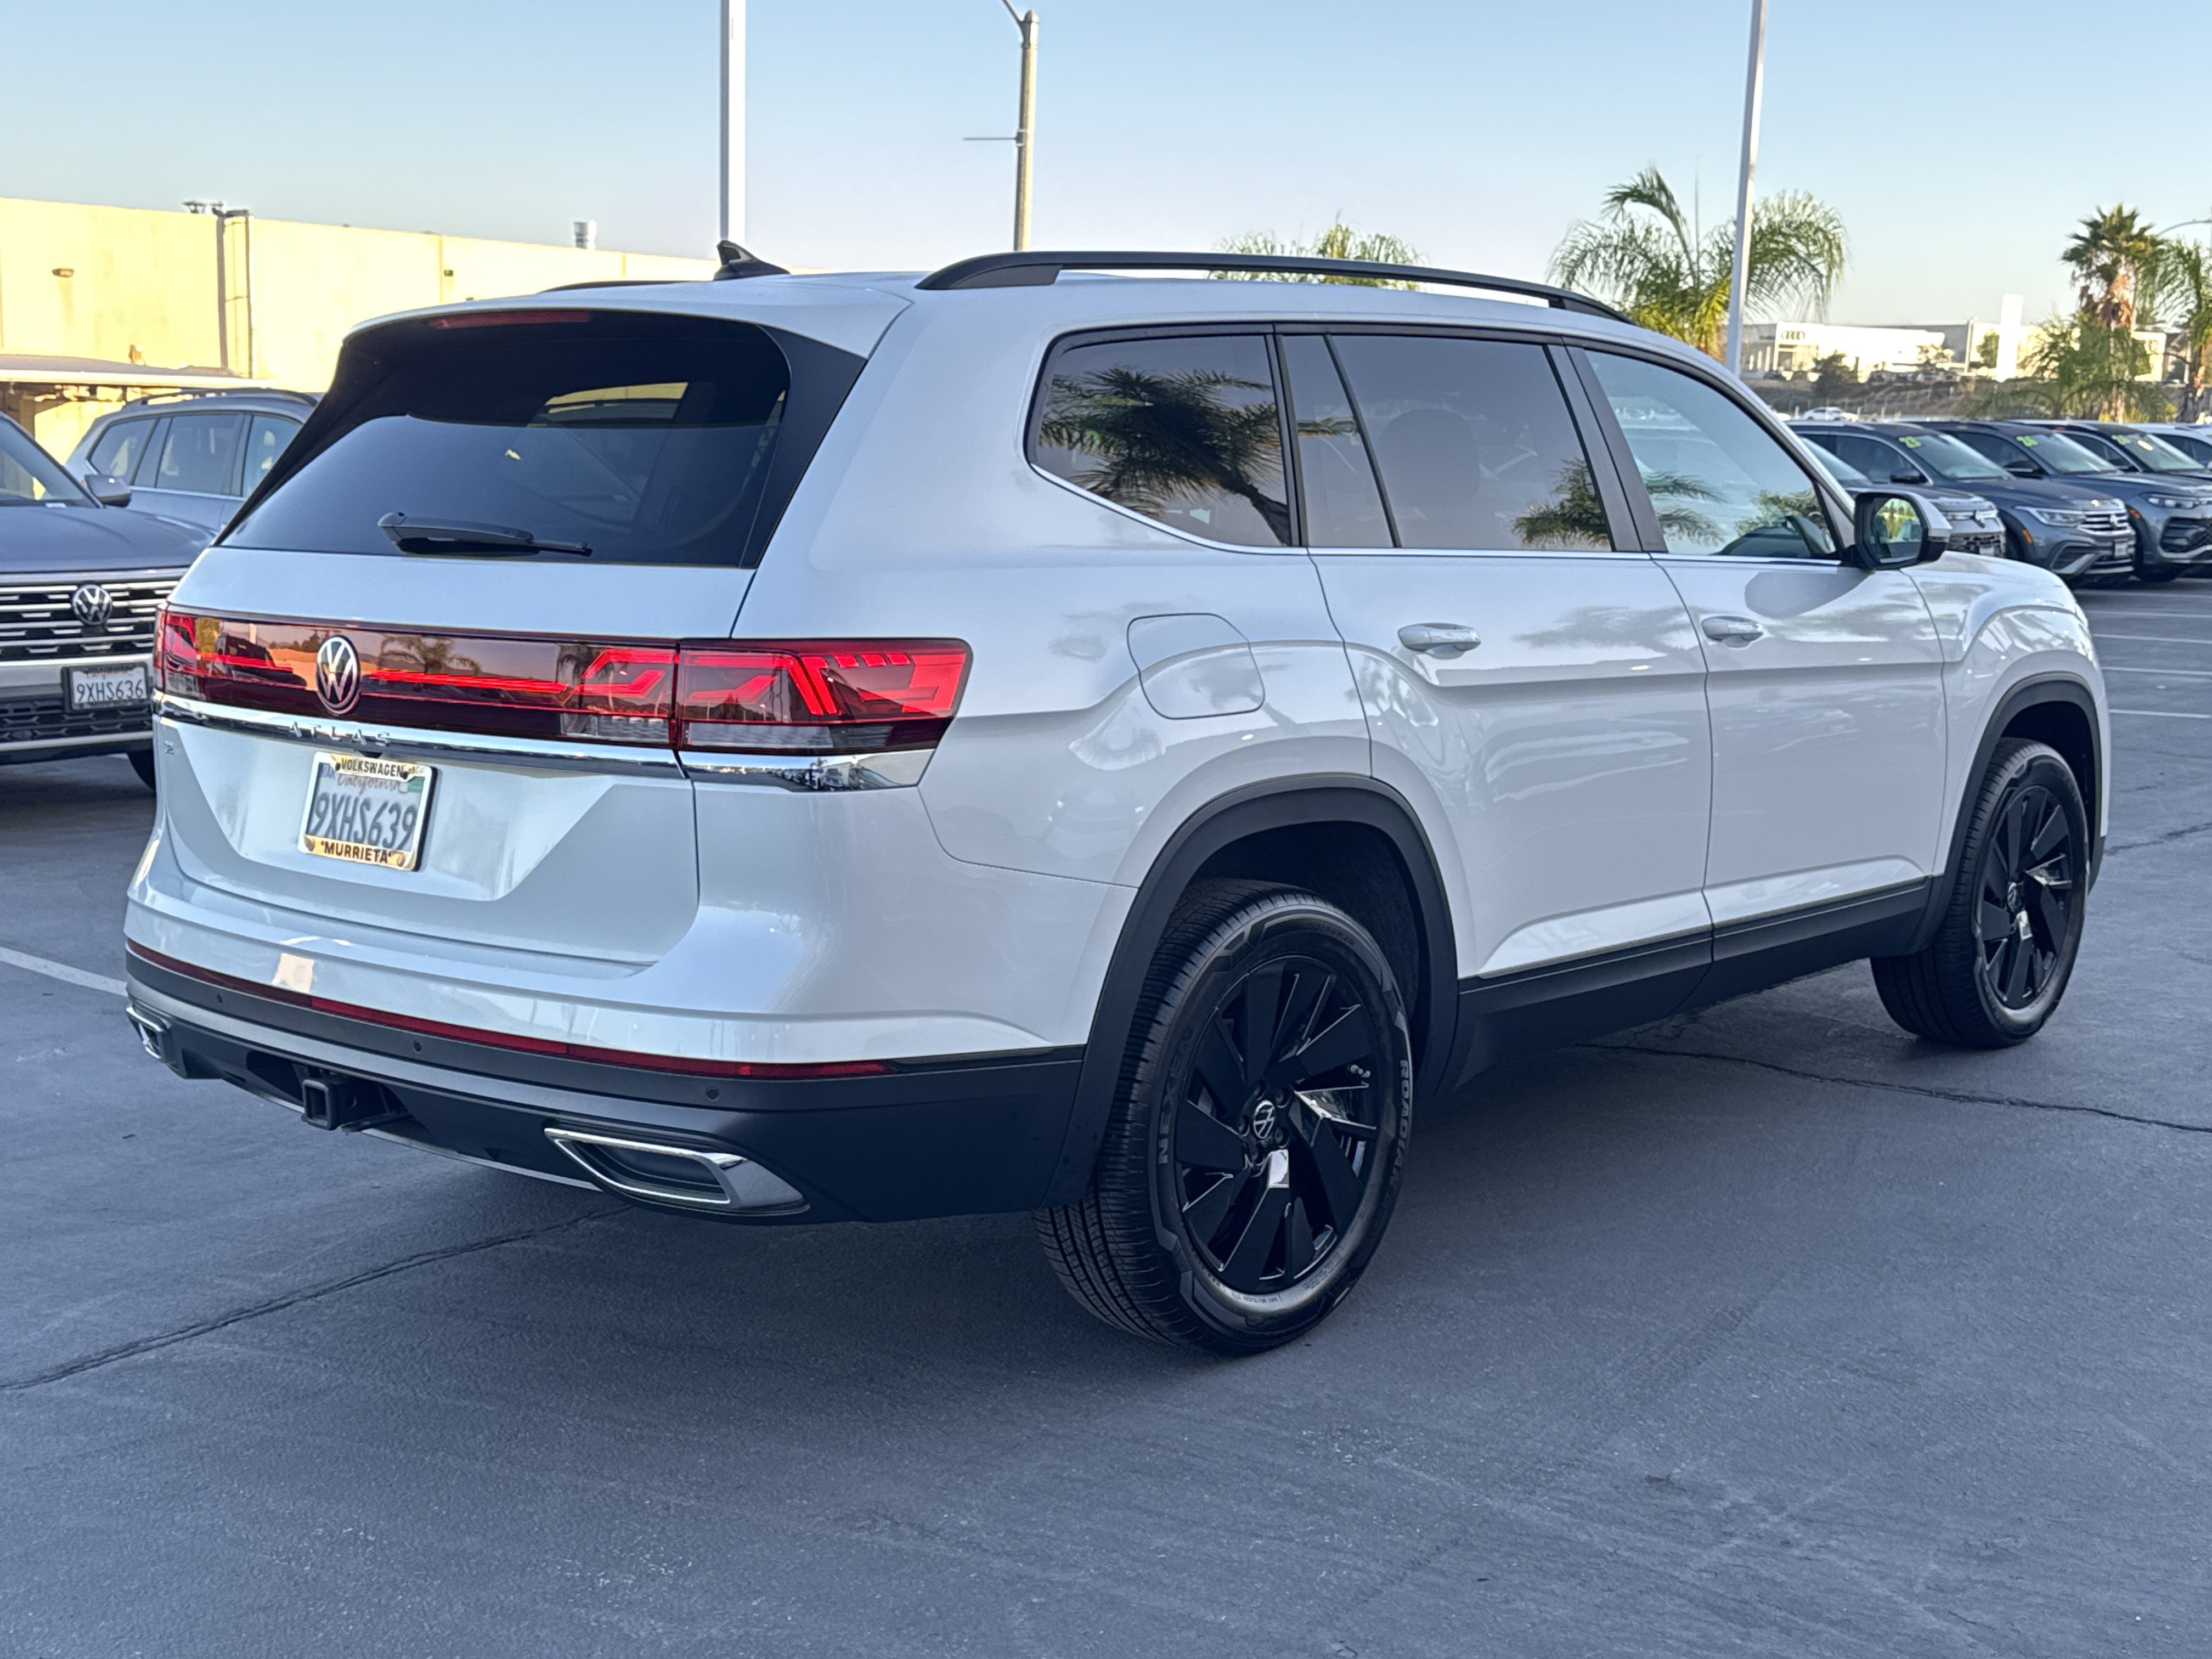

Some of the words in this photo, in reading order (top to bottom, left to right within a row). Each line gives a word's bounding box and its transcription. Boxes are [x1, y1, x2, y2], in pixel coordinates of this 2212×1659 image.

[76, 679, 143, 704] 9XHS636
[289, 721, 391, 747] ATLAS
[341, 758, 404, 777] VOLKSWAGEN
[311, 792, 417, 851] 9XHS639
[324, 841, 390, 864] MURRIETA
